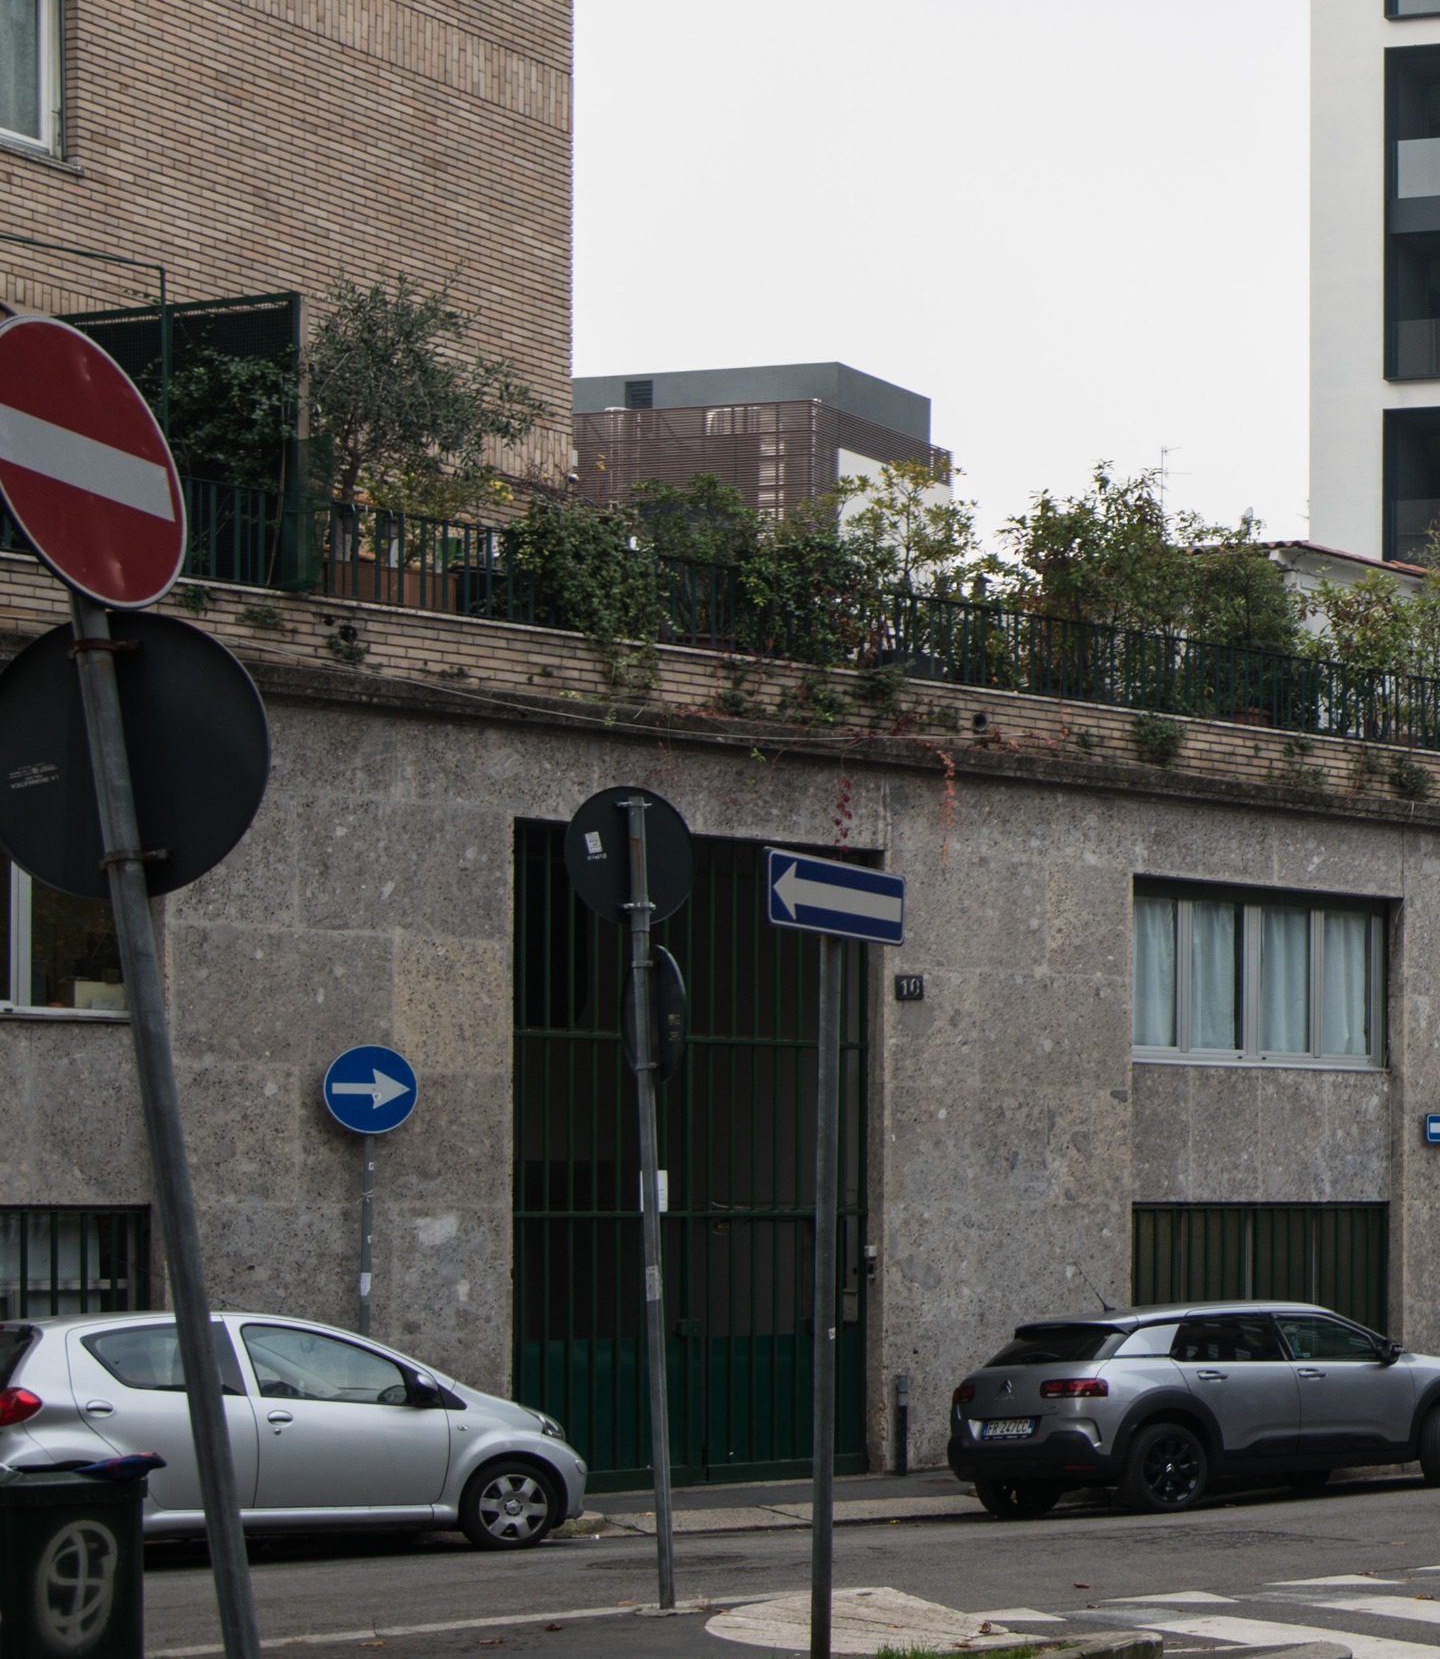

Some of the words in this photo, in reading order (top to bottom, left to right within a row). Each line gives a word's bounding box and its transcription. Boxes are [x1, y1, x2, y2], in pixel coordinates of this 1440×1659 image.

[900, 978, 920, 996] 10
[987, 1421, 999, 1434] FR
[1000, 1420, 1028, 1434] 247CC
